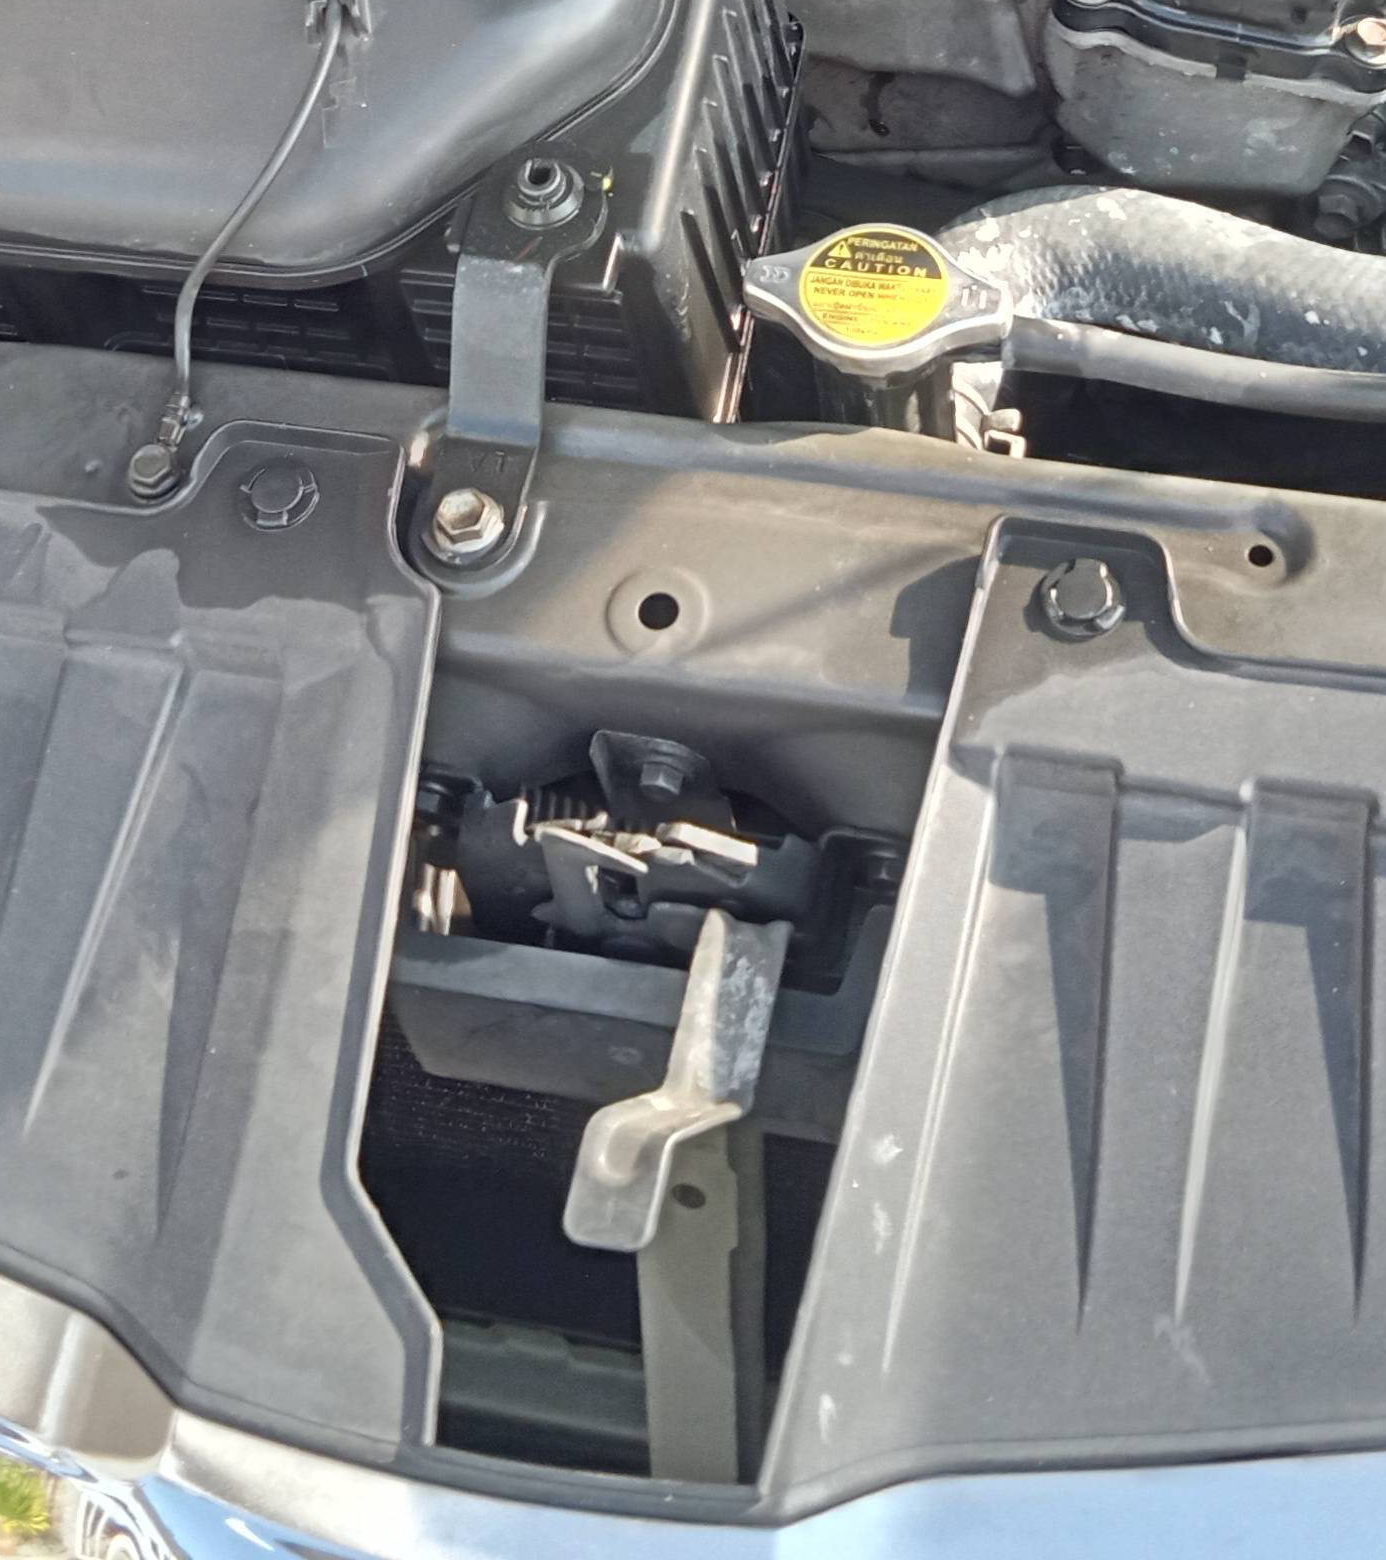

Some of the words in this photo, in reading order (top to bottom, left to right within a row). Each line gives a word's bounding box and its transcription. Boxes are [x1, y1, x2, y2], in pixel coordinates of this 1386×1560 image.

[847, 237, 918, 252] PERINGATAN
[824, 258, 928, 278] CAUTION
[814, 286, 846, 297] NEVER
[848, 289, 875, 299] OPEN
